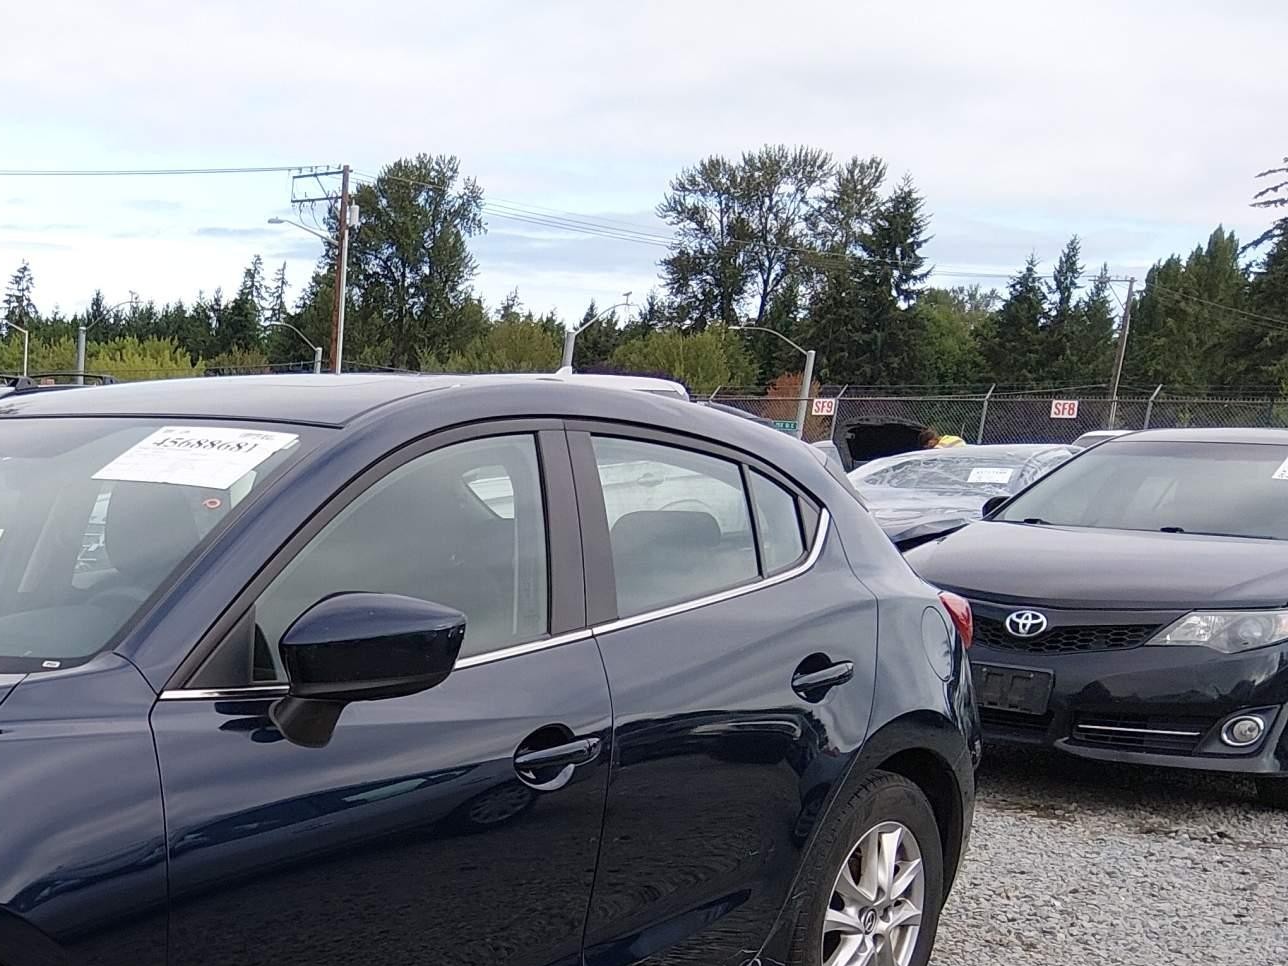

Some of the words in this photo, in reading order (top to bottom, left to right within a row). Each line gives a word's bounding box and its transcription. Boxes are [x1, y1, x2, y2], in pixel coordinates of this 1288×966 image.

[814, 400, 834, 413] SF9
[1054, 402, 1076, 416] SF8
[152, 436, 259, 454] 45688681
